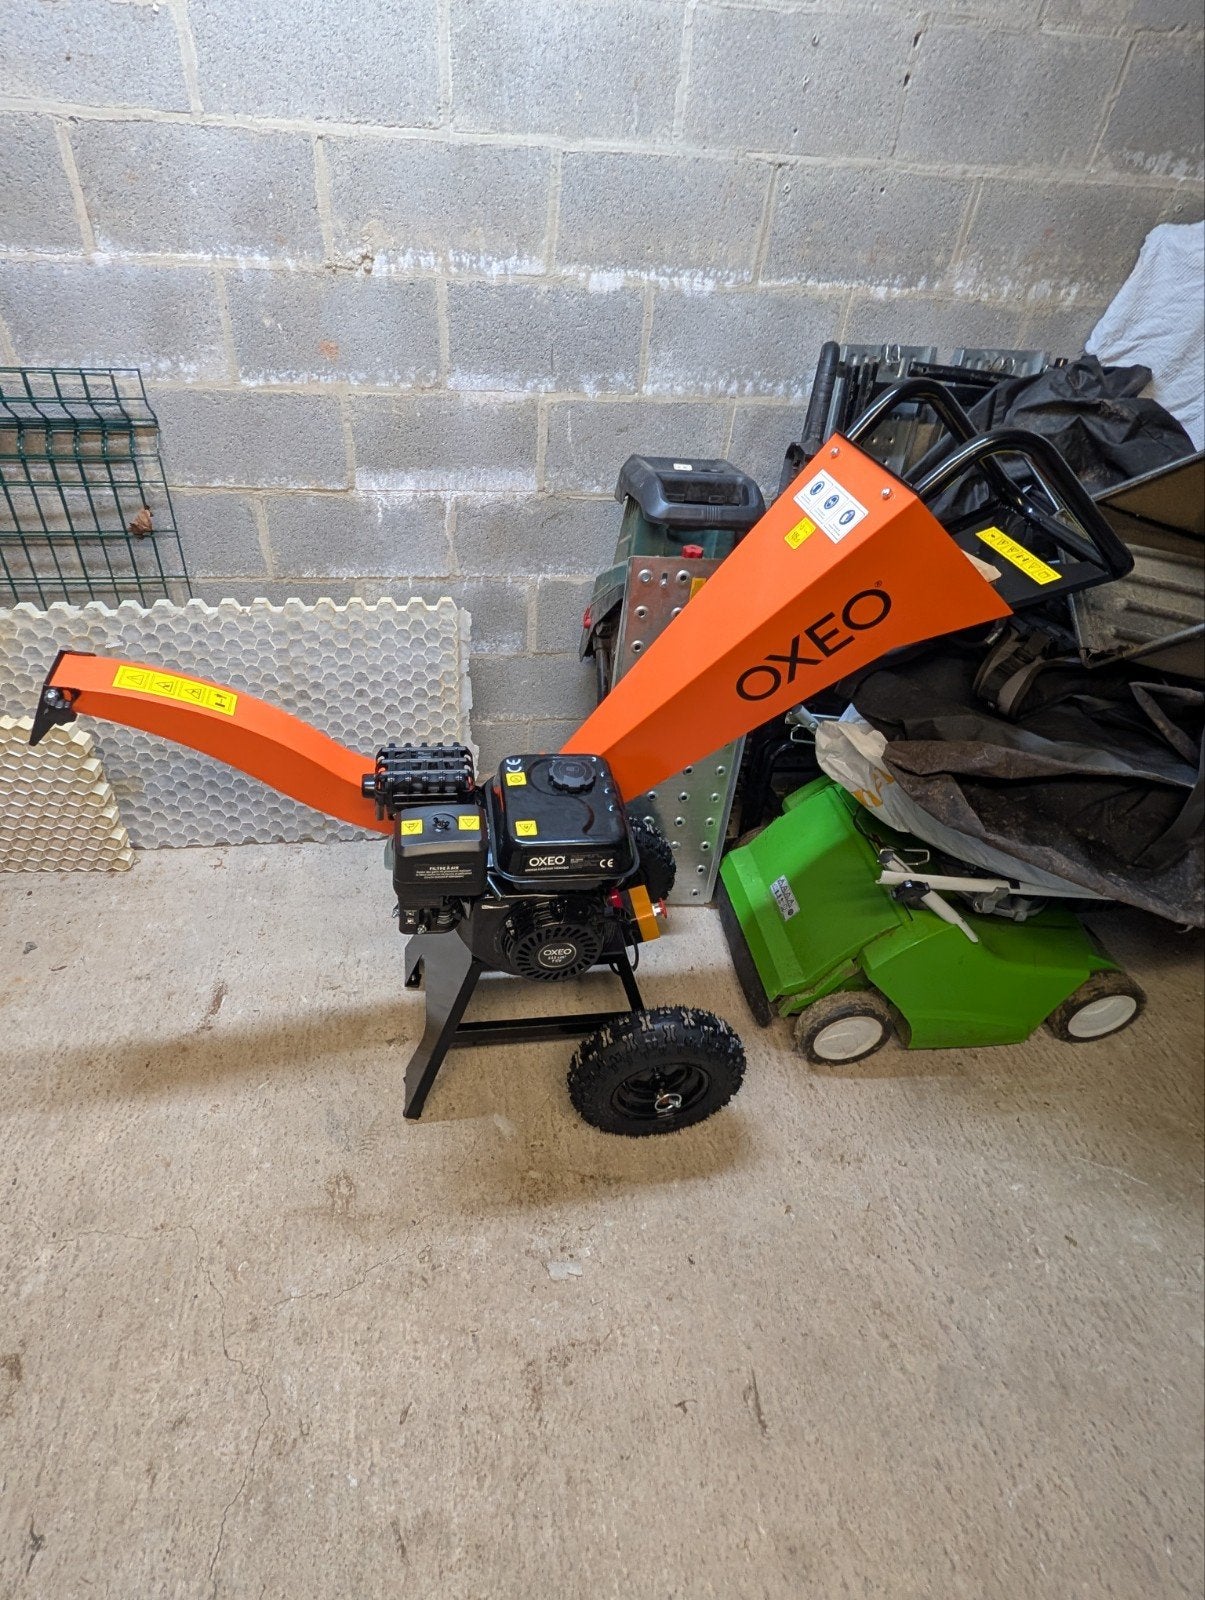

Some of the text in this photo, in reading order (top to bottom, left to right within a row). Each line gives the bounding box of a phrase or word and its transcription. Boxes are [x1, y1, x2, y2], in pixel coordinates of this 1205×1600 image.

[736, 588, 892, 702] OXEO
[529, 855, 566, 867] OXEO
[599, 858, 614, 868] CE
[543, 948, 572, 956] OXEO
